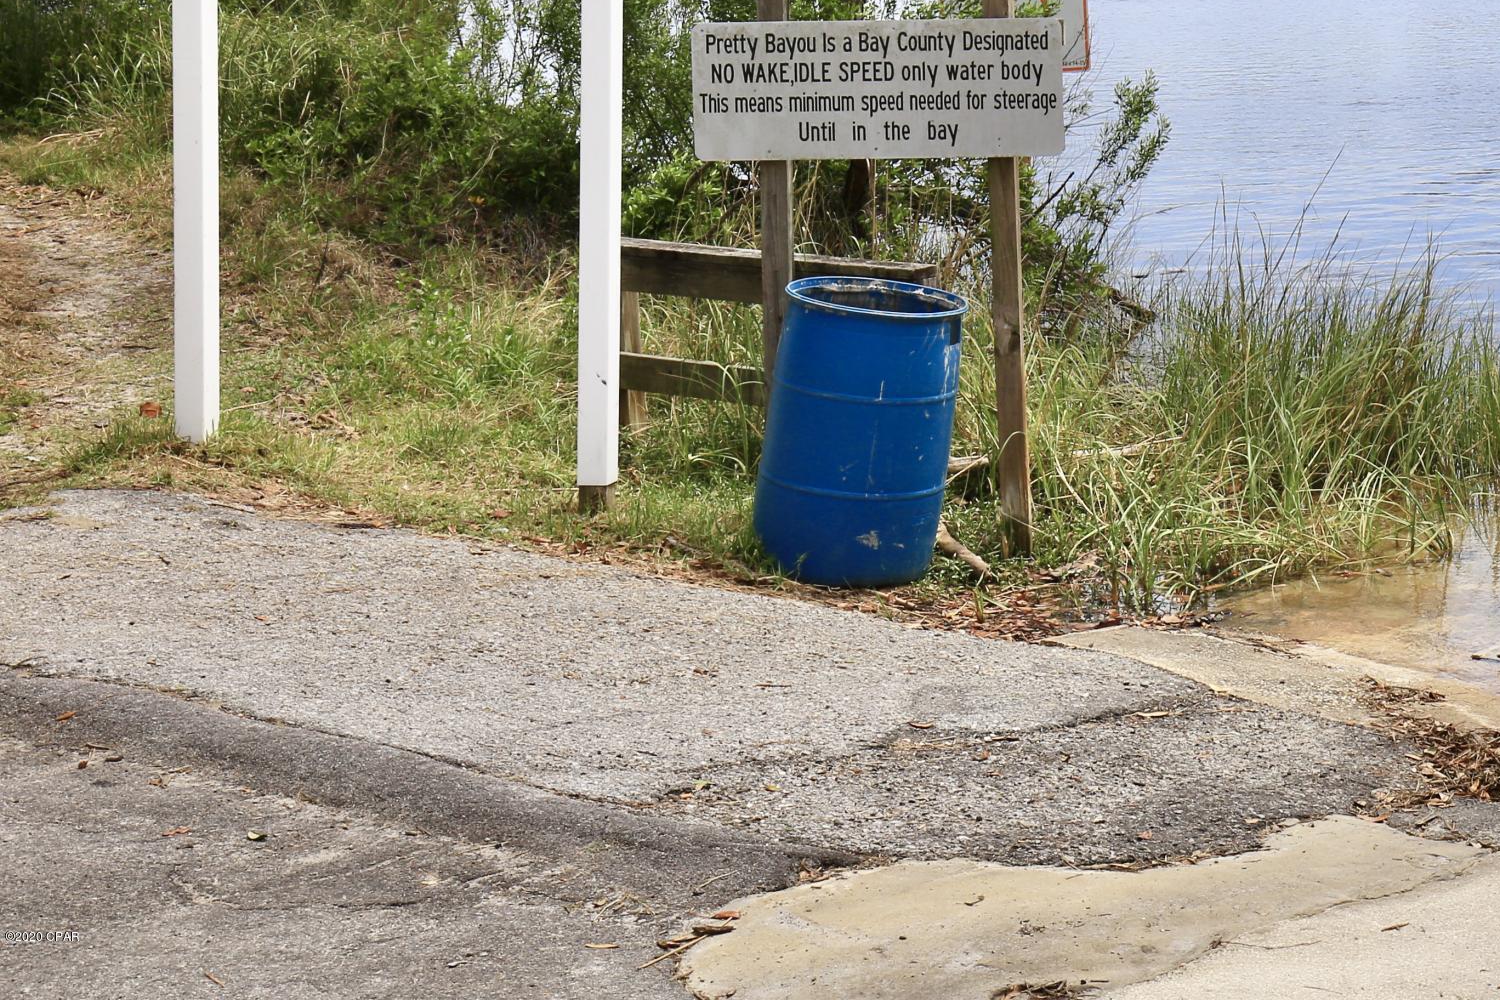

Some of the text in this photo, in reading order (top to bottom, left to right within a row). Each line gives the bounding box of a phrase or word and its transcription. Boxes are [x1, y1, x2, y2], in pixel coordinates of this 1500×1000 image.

[705, 29, 1049, 61] Pretty Bayou Is a Bay County Designated
[711, 63, 735, 84] NO
[838, 61, 895, 83] SPEED
[901, 61, 939, 89] only
[945, 61, 995, 81] water
[1001, 60, 1044, 87] body
[699, 89, 1057, 118] This means minimum speed needed for steerage
[798, 120, 959, 147] Until in the bay
